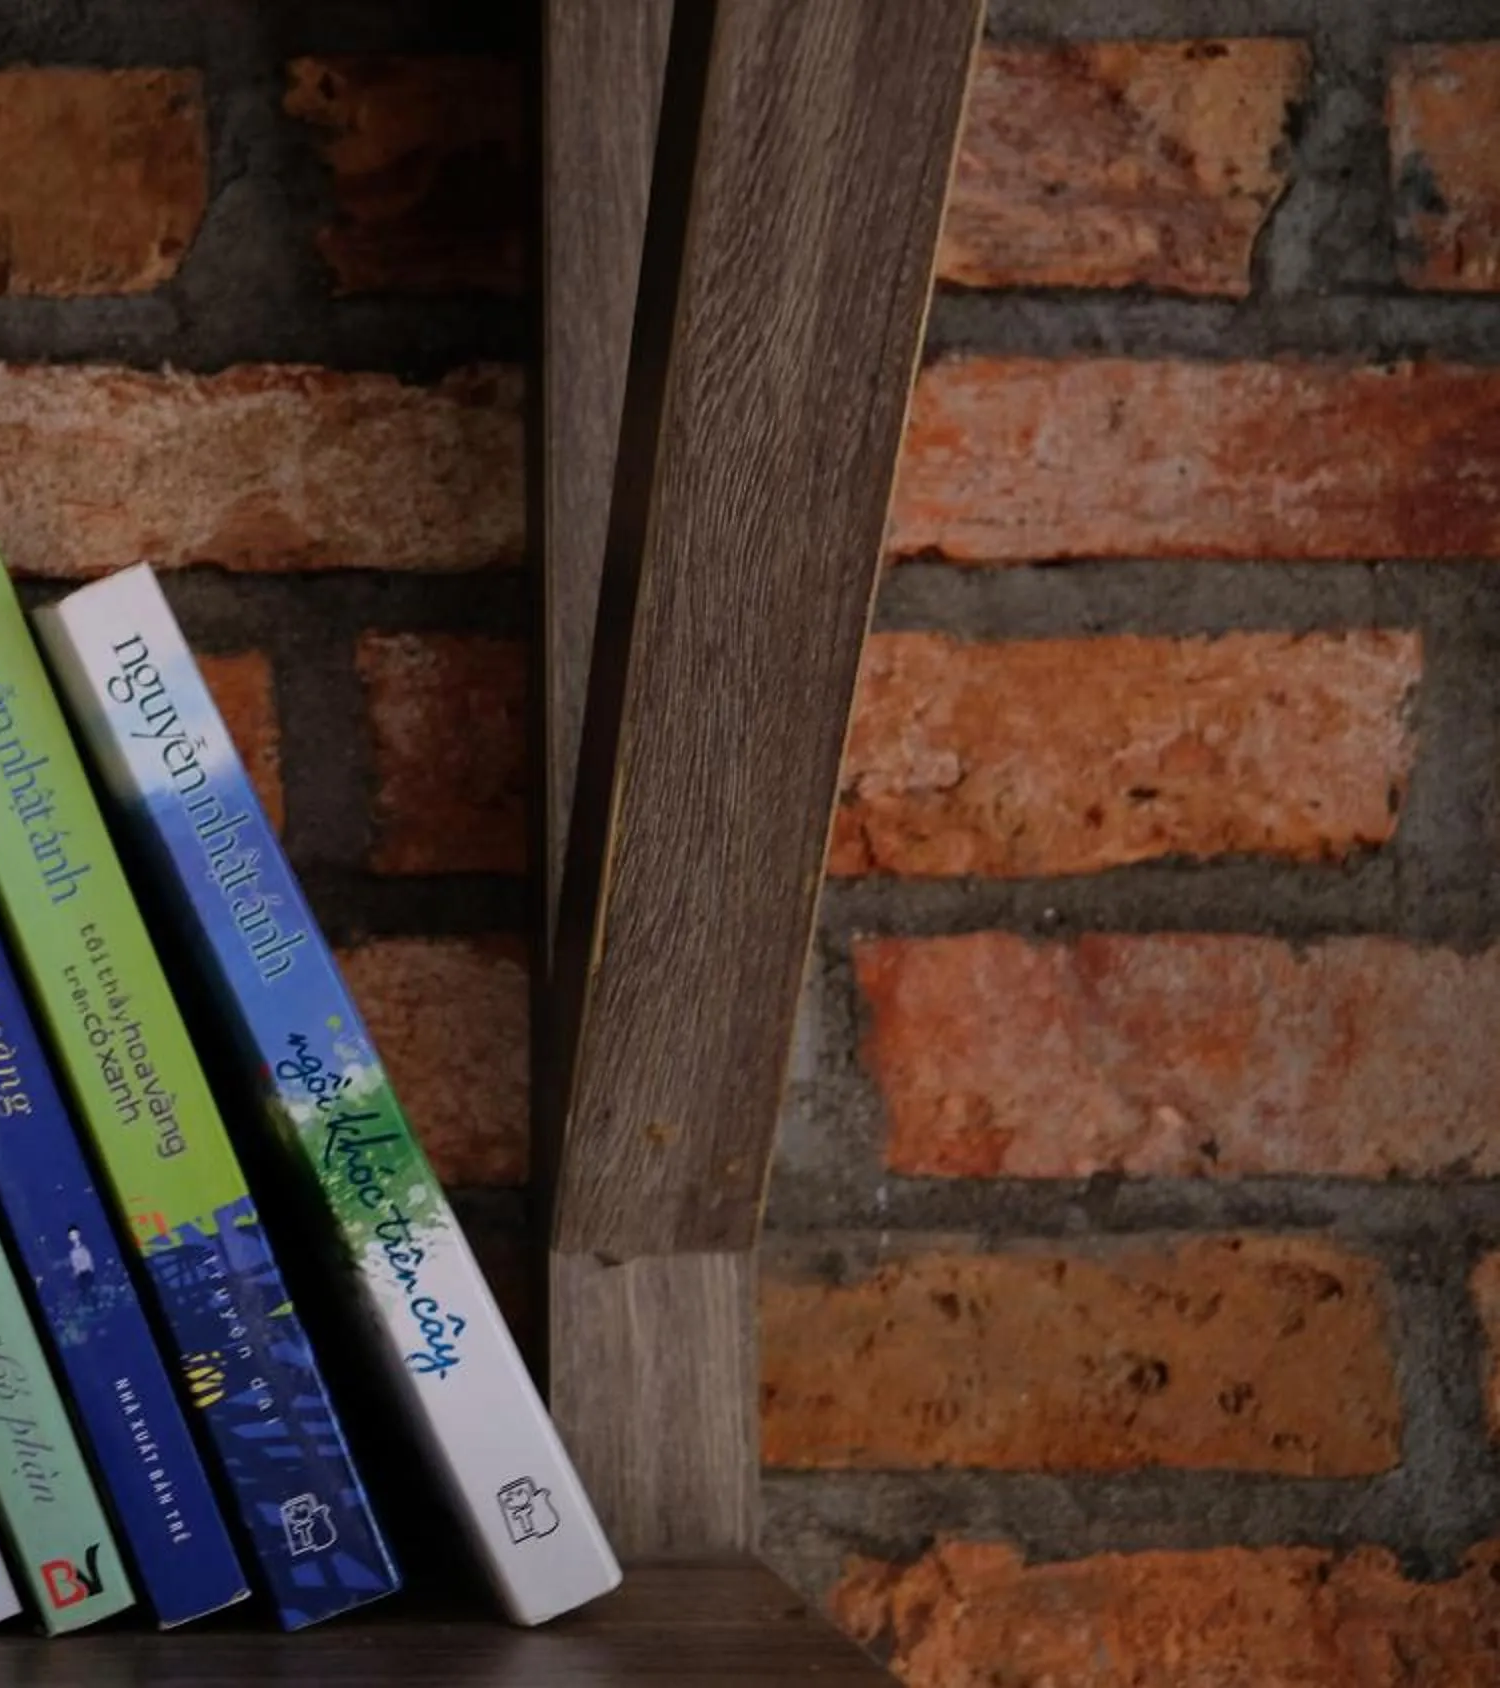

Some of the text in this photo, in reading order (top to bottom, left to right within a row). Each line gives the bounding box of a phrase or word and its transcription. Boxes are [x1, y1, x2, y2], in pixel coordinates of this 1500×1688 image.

[106, 633, 309, 983] nguyễn nhật ánh
[27, 830, 92, 905] ánh
[95, 1046, 141, 1125] xanh
[119, 1020, 155, 1080] hoa
[131, 1076, 188, 1160] vàng
[274, 1031, 466, 1381] ngồi khóc trên cây
